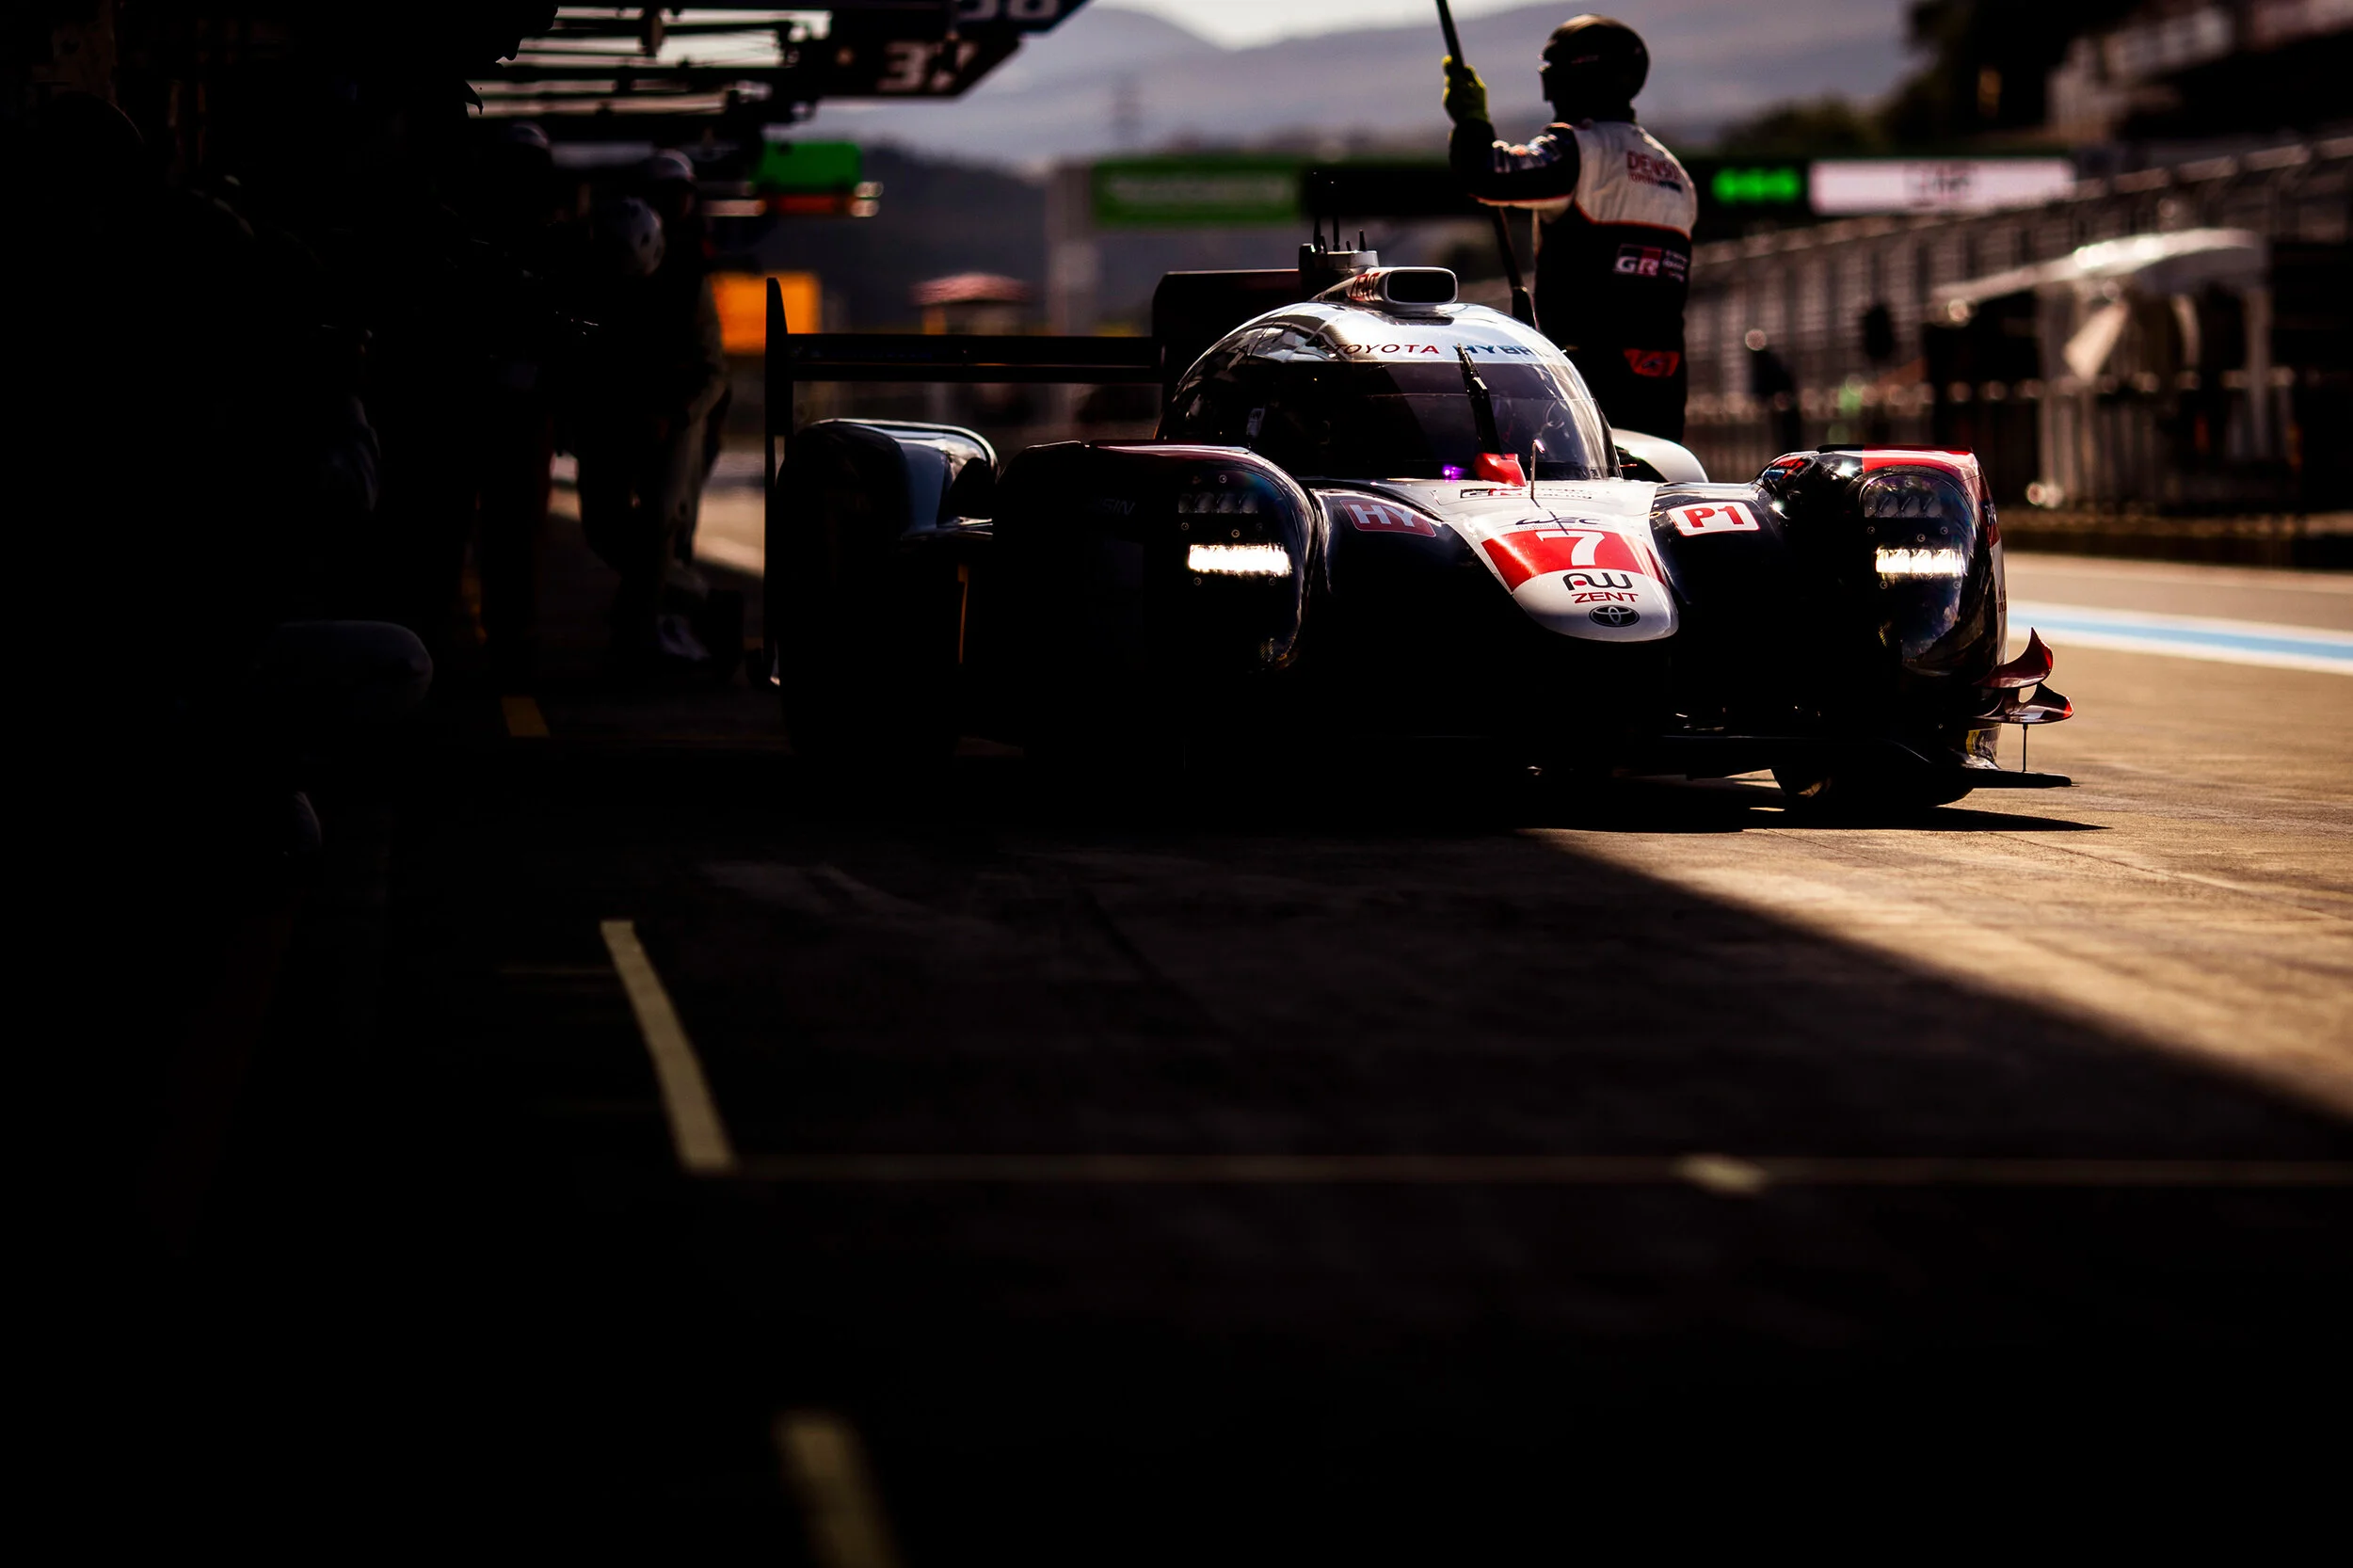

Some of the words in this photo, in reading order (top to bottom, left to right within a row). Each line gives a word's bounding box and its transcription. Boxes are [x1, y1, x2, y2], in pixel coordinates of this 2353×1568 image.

[1627, 151, 1681, 181] DENSO
[1616, 256, 1659, 276] GR
[1336, 344, 1441, 355] TOYOTA
[1349, 504, 1415, 527] HY
[1683, 505, 1745, 528] P1
[1535, 530, 1606, 567] 7
[1571, 591, 1640, 604] ZENT
